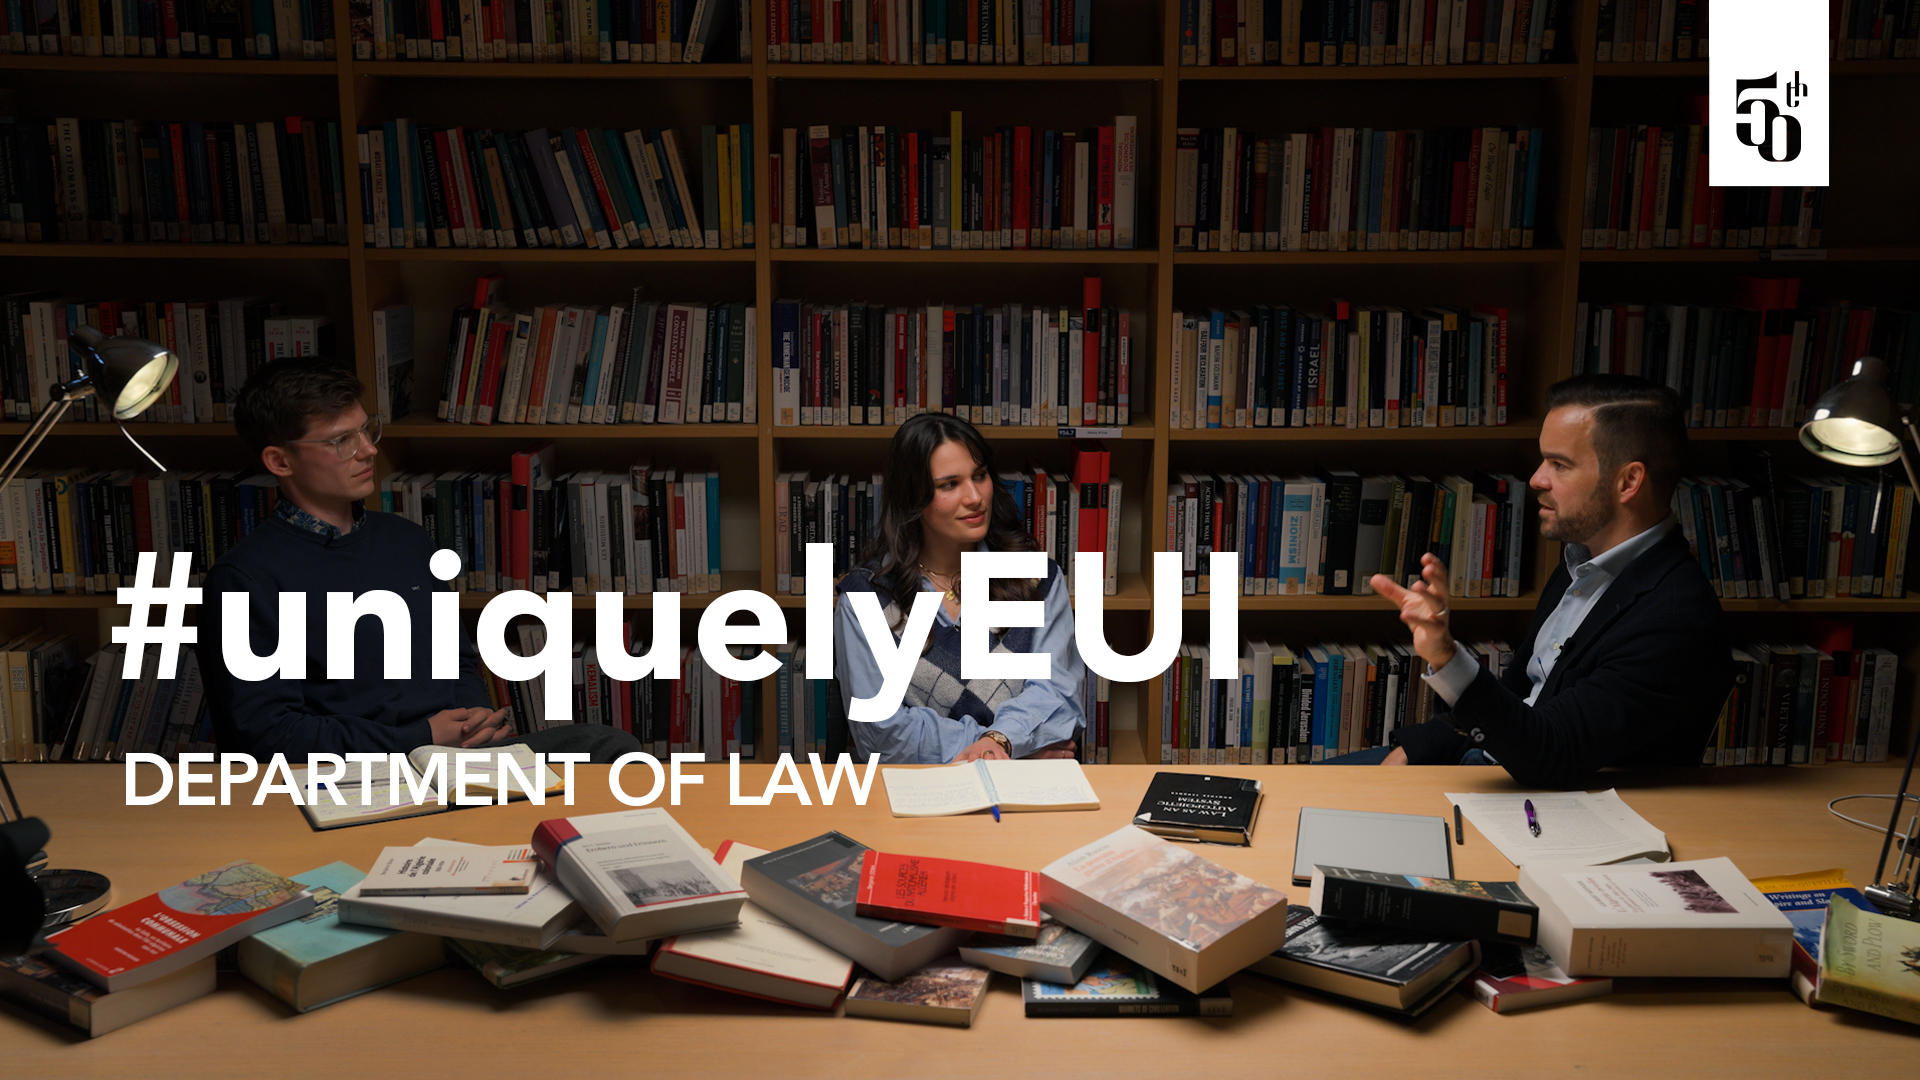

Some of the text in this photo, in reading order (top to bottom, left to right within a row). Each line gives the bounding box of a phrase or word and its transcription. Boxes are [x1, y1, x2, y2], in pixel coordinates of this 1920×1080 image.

[1302, 173, 1312, 232] NAZI PALESTINE
[276, 342, 284, 357] THE
[303, 341, 311, 355] THE
[668, 314, 681, 384] CONSTANTINOPLE
[1199, 329, 1209, 389] BALFOUR DECLARATION
[1308, 344, 1320, 390] ISRAEL
[34, 487, 44, 517] Thirteen
[1204, 486, 1213, 510] ACROSS
[37, 517, 46, 534] Days
[778, 505, 788, 536] IRAQ
[808, 520, 817, 543] BRITAI
[1203, 511, 1211, 524] THE
[1203, 524, 1211, 541] WALL
[1287, 515, 1300, 565] ZIONISM
[40, 542, 49, 574] September
[587, 664, 599, 707] KEMALISM
[1299, 688, 1312, 743] Divided Jerusalem
[1775, 691, 1792, 748] VIETNAM
[1815, 677, 1830, 737] INDOCHINA
[1156, 799, 1237, 812] AUTOPOIETIC
[1177, 796, 1220, 805] SYSTEM
[1197, 809, 1226, 817] LAW
[896, 887, 907, 900] LES
[1768, 891, 1827, 902] Writings on
[1794, 898, 1814, 907] and
[1844, 921, 1858, 960] SWORD
[1863, 919, 1884, 972] AND PLOW
